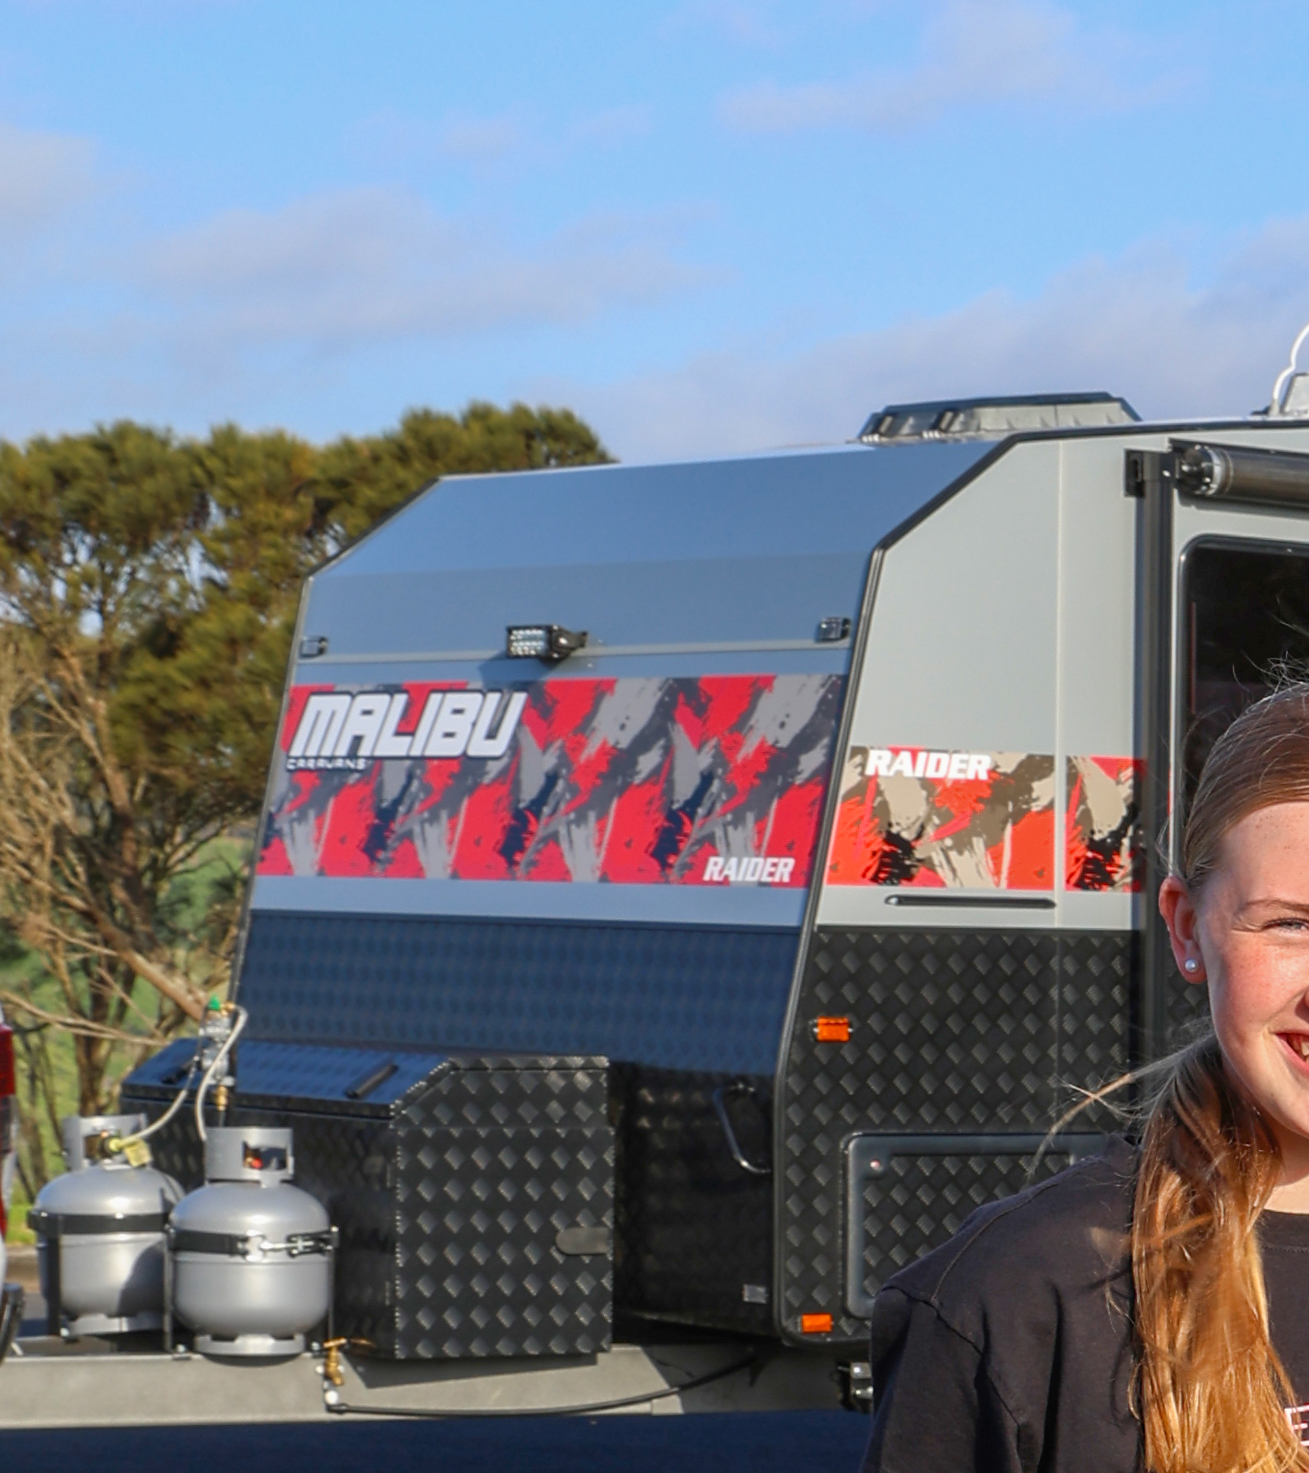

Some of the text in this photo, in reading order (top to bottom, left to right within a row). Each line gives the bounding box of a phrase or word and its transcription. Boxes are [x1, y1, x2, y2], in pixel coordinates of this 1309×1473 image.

[288, 691, 529, 758] MALIBU
[286, 757, 367, 771] CARAVANS
[864, 748, 991, 780] RAIDER
[702, 856, 796, 883] RAIDER
